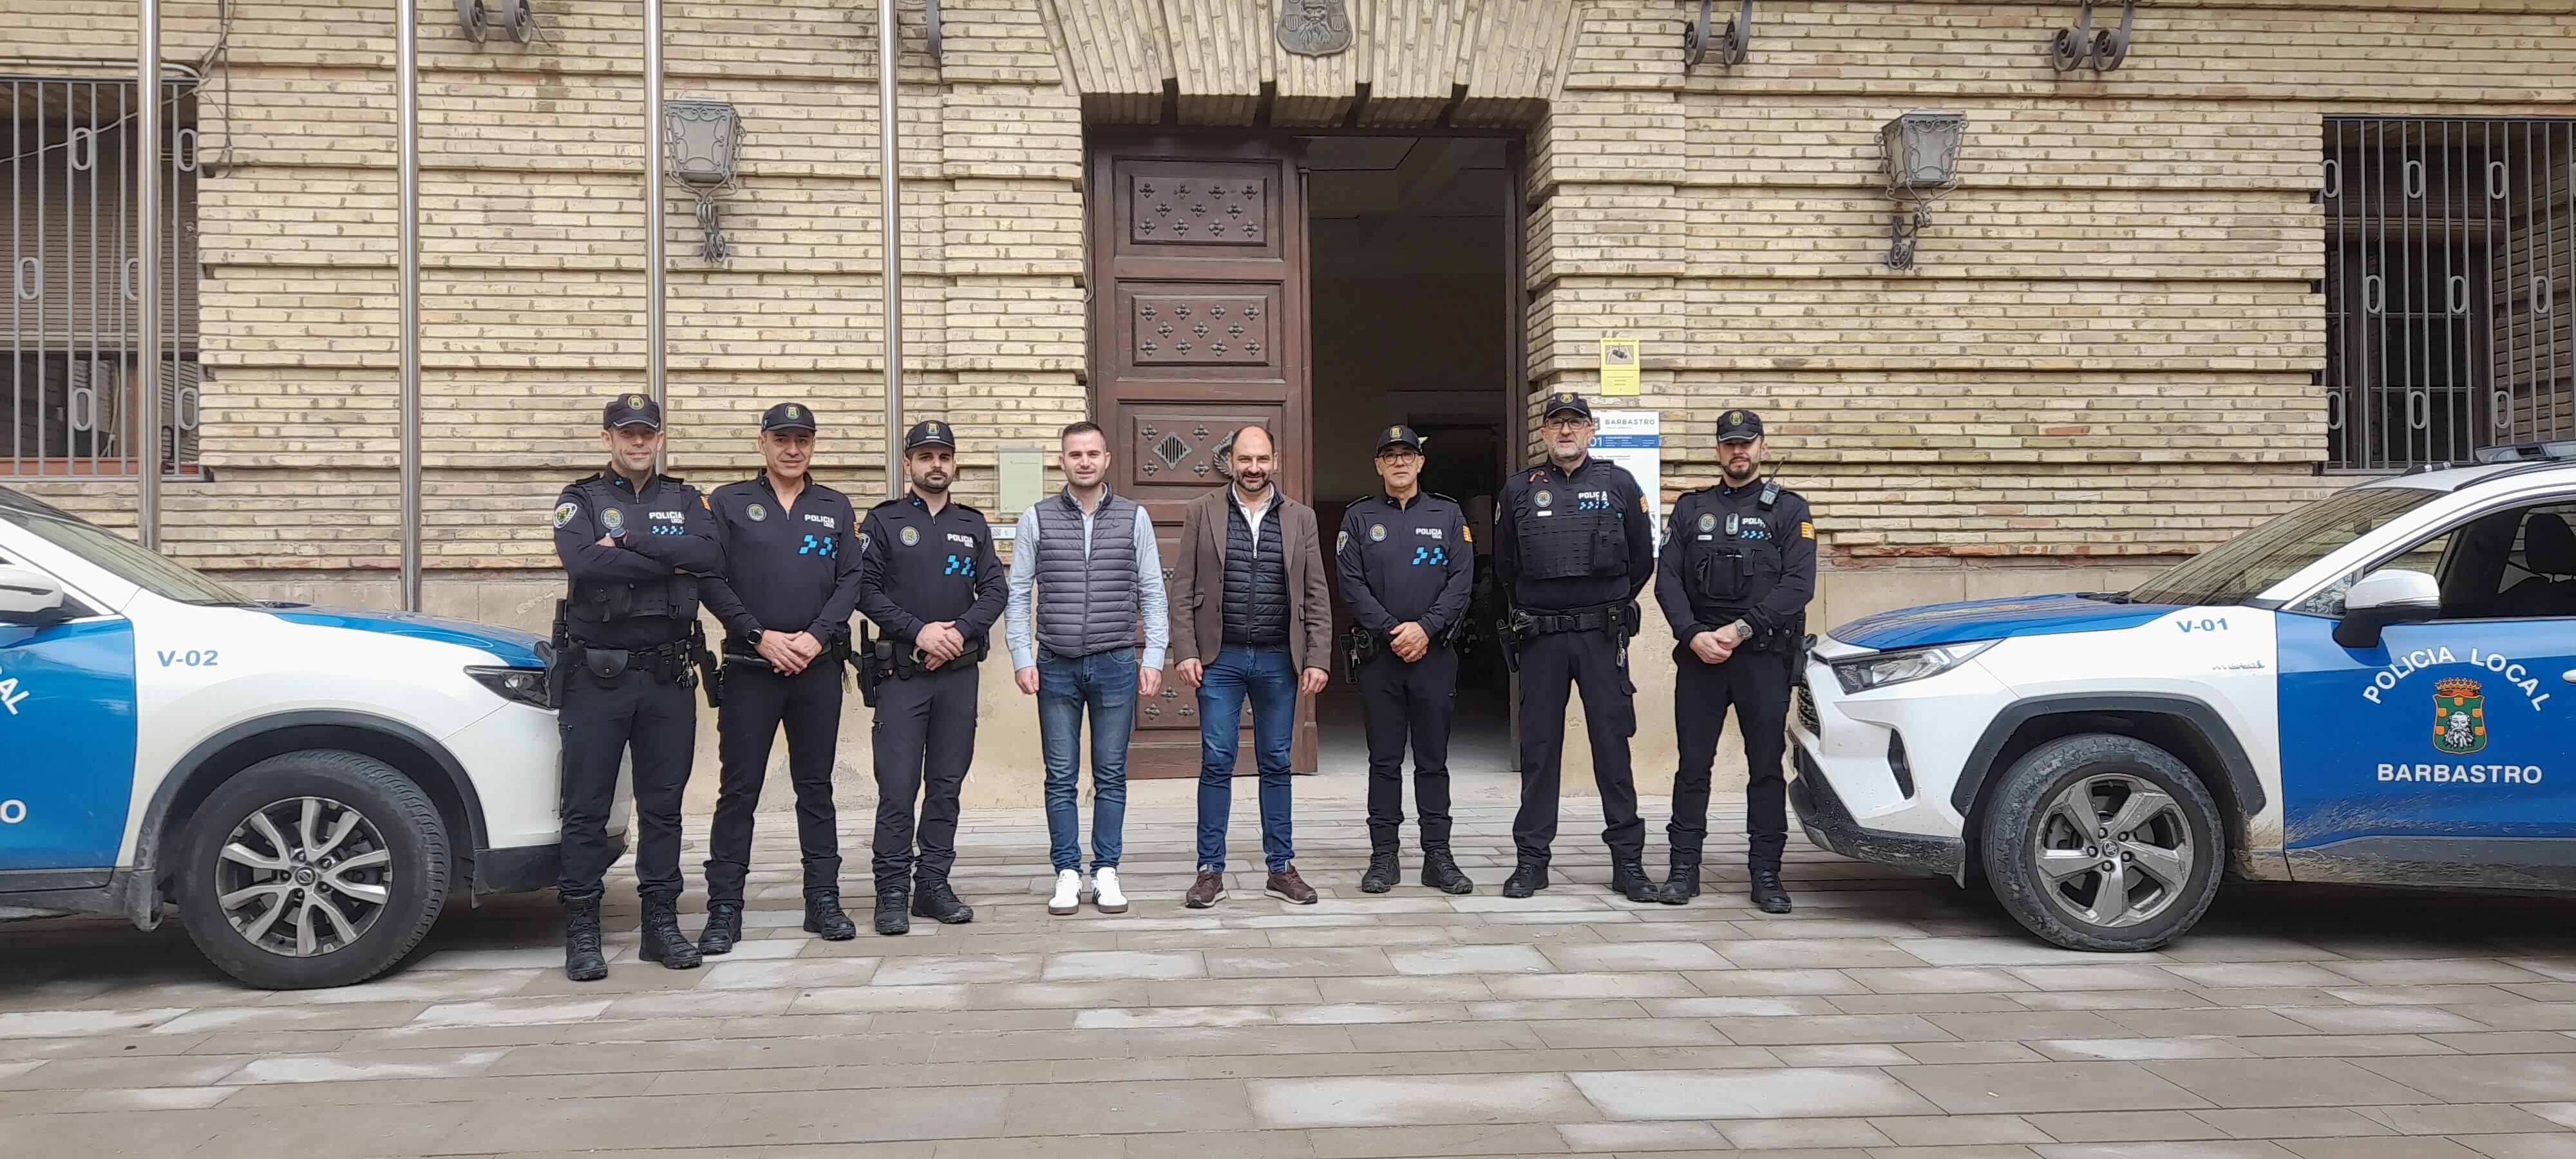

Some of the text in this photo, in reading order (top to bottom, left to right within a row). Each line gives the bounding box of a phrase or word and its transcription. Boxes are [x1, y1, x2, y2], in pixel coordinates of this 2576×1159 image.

[649, 511, 685, 520] POLICIA
[804, 514, 835, 525] POLICIA
[947, 534, 973, 543] POLICIA
[2176, 617, 2228, 632] V-01
[156, 650, 218, 666] V-02
[2363, 646, 2551, 711] POLICIA LOCAL
[2377, 763, 2543, 784] BARBASTRO
